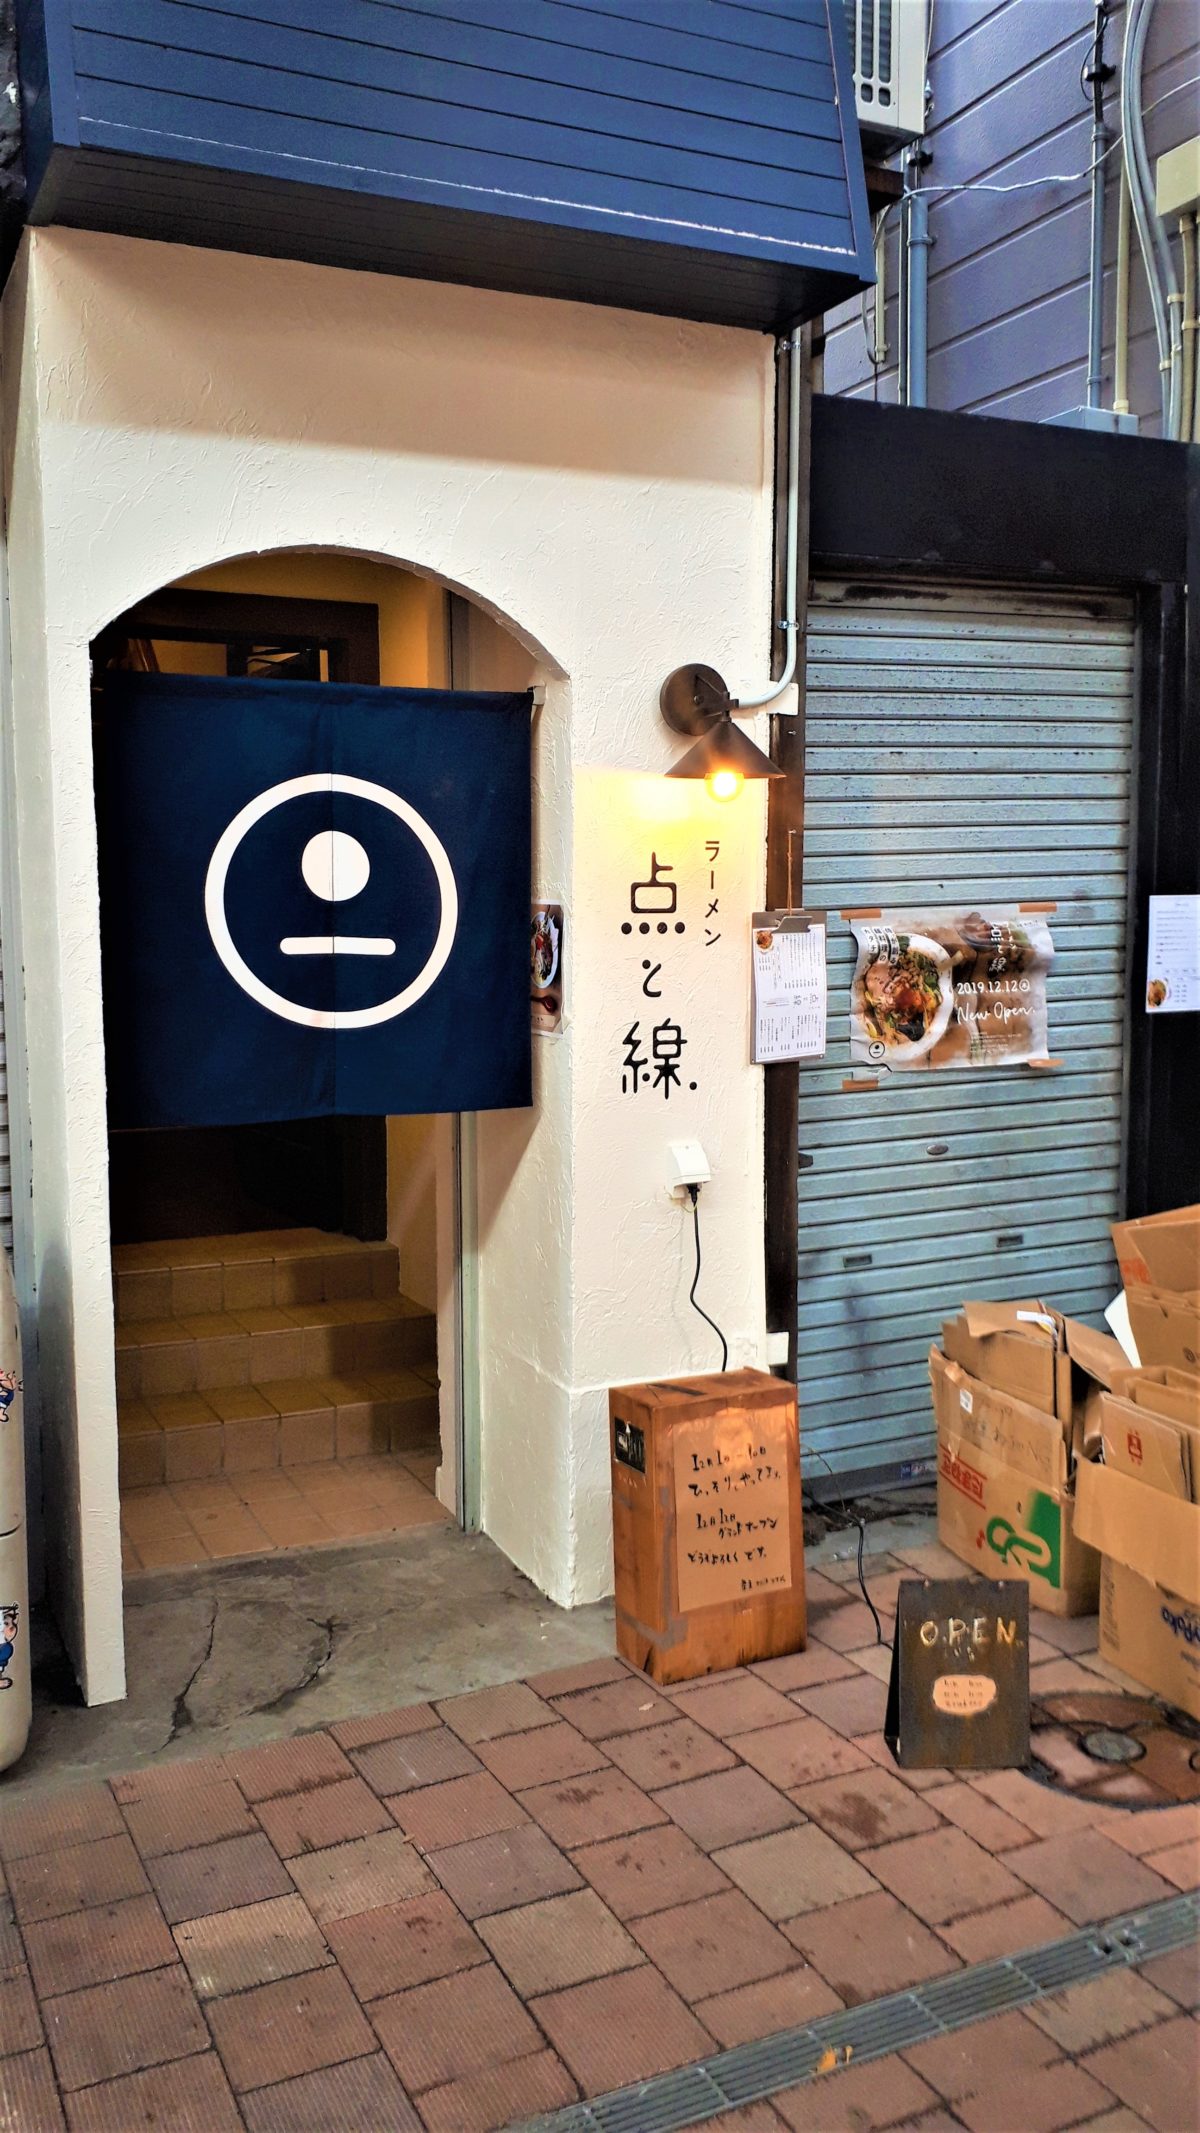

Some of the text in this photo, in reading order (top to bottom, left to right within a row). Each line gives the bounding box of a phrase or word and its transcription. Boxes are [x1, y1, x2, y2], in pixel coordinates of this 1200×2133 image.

[704, 840, 722, 947] ラーメン
[957, 1001, 991, 1025] New
[920, 1616, 1017, 1647] OPEN
